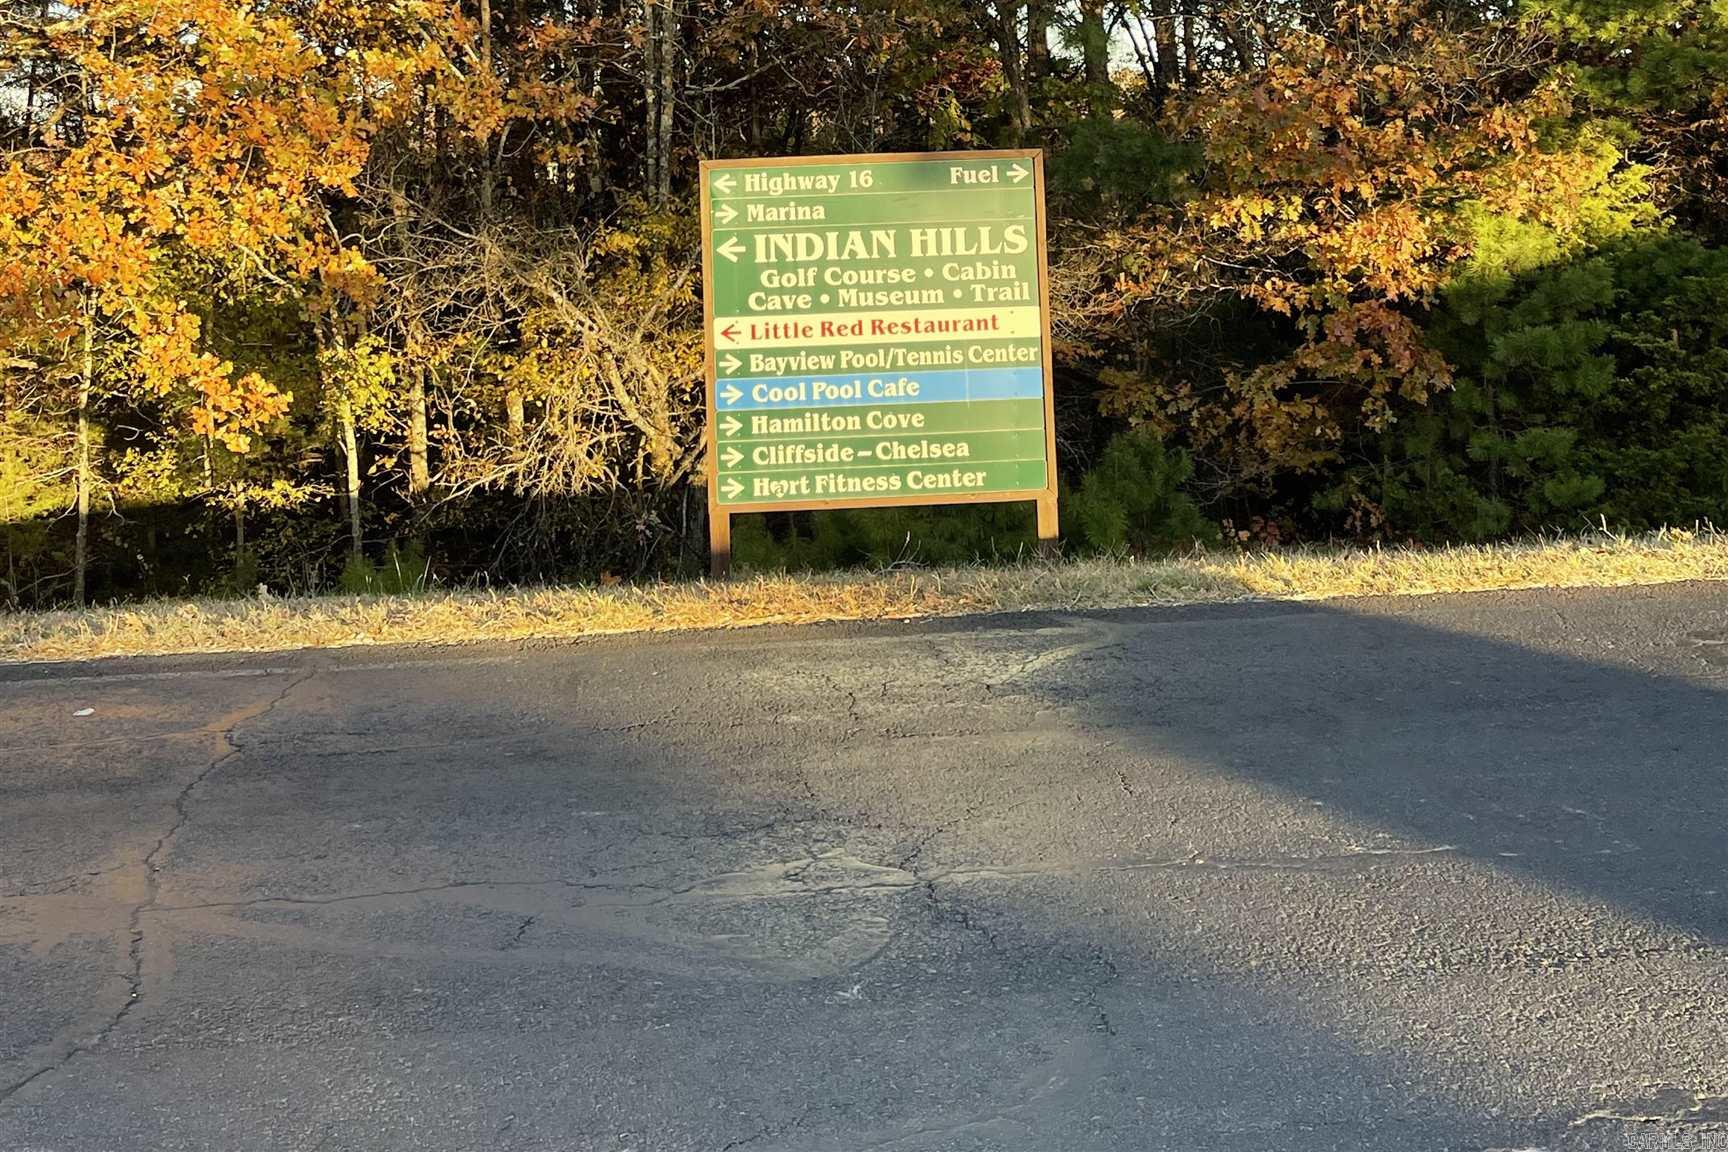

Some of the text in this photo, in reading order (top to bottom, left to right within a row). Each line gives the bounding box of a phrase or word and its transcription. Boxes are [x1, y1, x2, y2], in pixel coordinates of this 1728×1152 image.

[745, 170, 873, 195] Highway 16
[950, 166, 999, 184] Fuel
[746, 202, 825, 222] Marina
[754, 224, 1028, 263] INDIAN HILLS
[760, 261, 1017, 288] Golf Course Cabin
[748, 282, 1030, 311] Cave Museum Trail
[751, 314, 1000, 340] Little Red Restaurant
[750, 344, 1038, 376] Bayview Pool/Tennis Center
[752, 378, 920, 403] Cool Pool Cafe
[751, 410, 925, 434] Hamilton Cove
[815, 472, 902, 494] Fitness
[906, 468, 987, 490] Center
